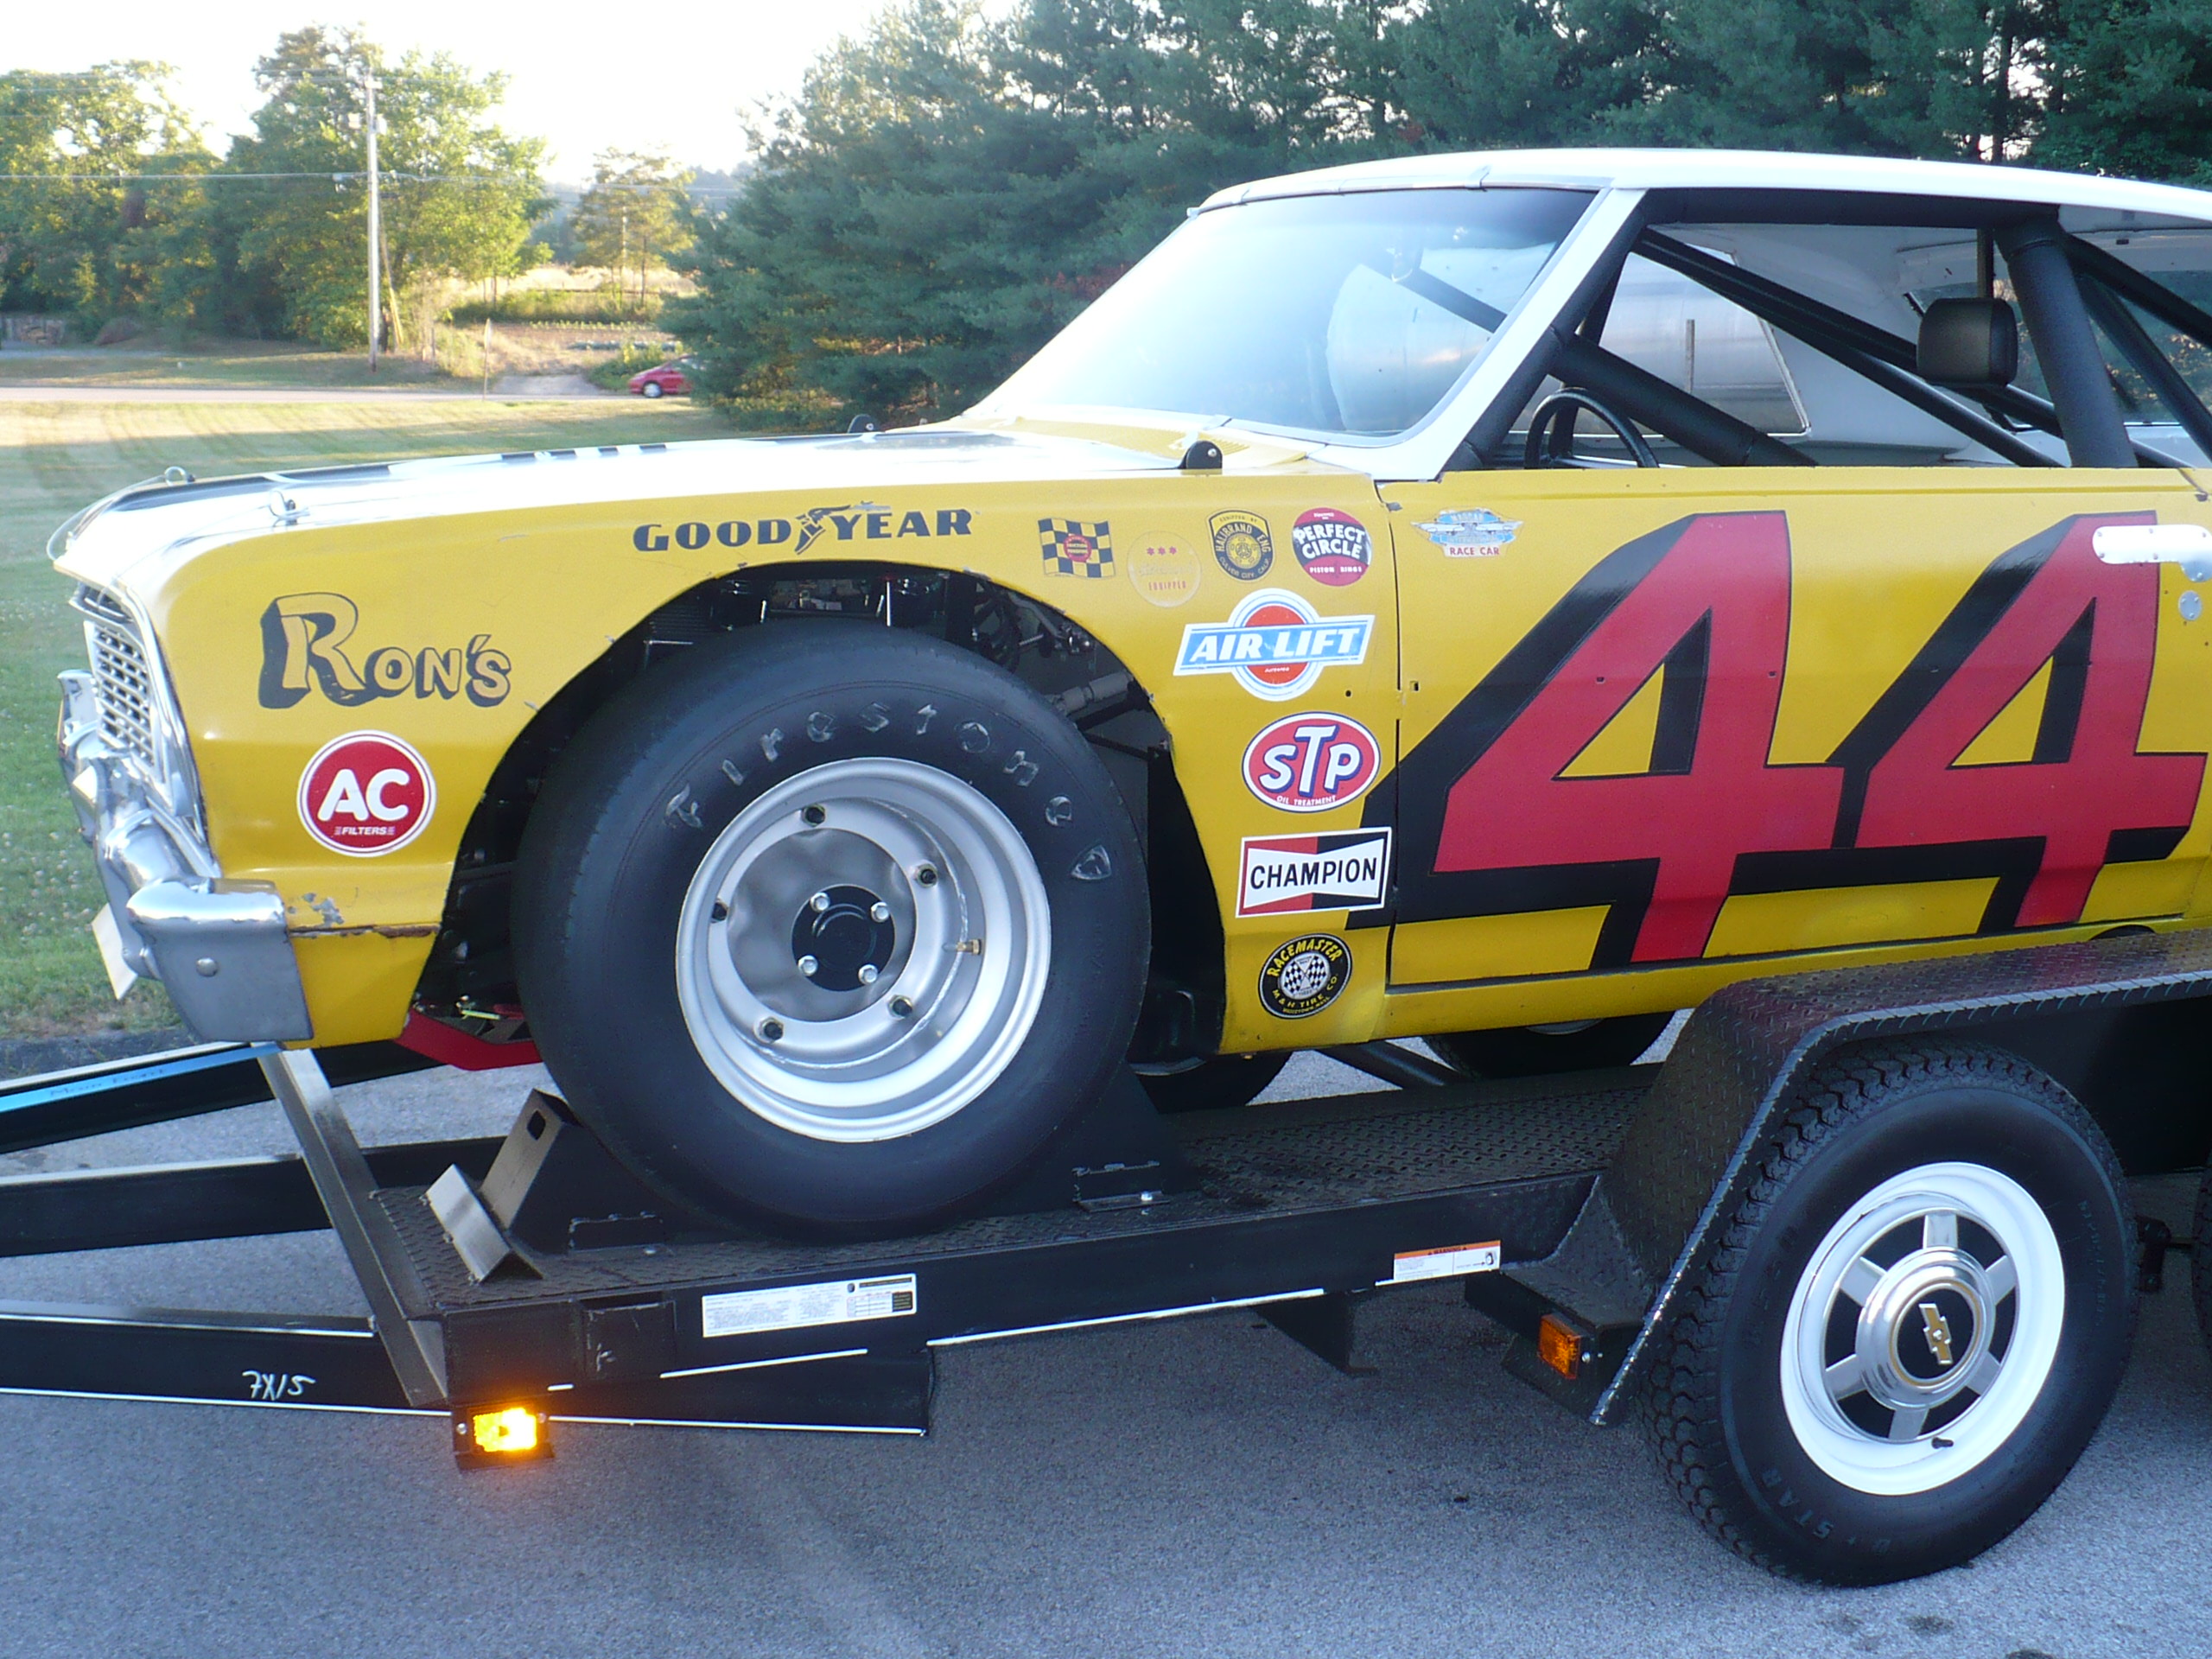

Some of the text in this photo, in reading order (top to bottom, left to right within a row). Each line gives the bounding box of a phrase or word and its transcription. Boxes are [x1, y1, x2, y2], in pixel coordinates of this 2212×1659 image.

[1216, 523, 1271, 552] HALIBRAND ENG
[1293, 524, 1365, 544] PERFECT
[1302, 538, 1363, 559] CIRCLE
[1449, 547, 1500, 556] RACE CAR
[1189, 627, 1360, 663] AIR LIFT
[1259, 724, 1363, 798] STP
[317, 768, 410, 822] AC
[1276, 795, 1336, 806] OIL TREATMENT
[341, 826, 388, 836] FILTERS
[1249, 857, 1377, 889] CHAMPION
[1267, 938, 1343, 976] RACEMASTER
[1300, 994, 1324, 1007] TIRE
